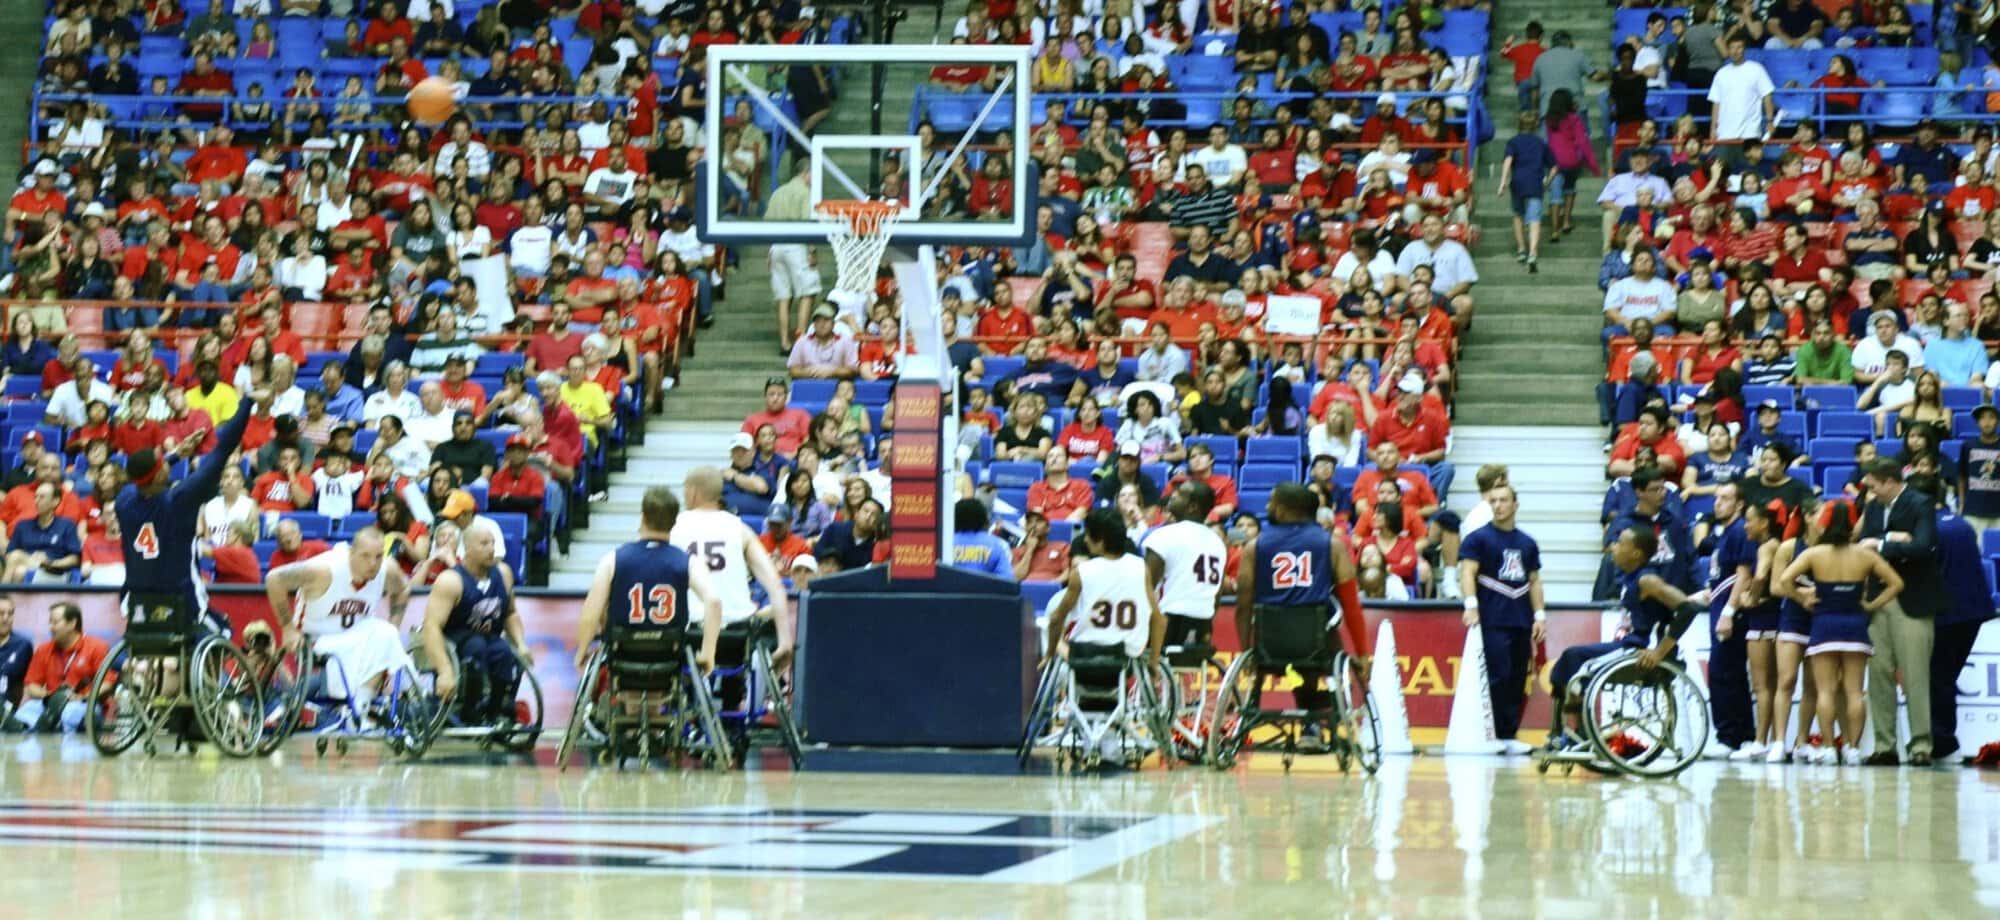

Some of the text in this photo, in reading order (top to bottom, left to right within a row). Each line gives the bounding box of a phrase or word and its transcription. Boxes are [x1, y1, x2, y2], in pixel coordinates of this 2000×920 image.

[899, 397, 936, 407] WELLS
[896, 445, 933, 455] WELLS
[894, 494, 932, 504] WELLS
[133, 522, 159, 560] 4
[894, 544, 932, 554] WELLS
[1193, 554, 1220, 584] 45
[1272, 551, 1312, 588] 21
[628, 583, 676, 624] 13
[1090, 600, 1137, 629] 30
